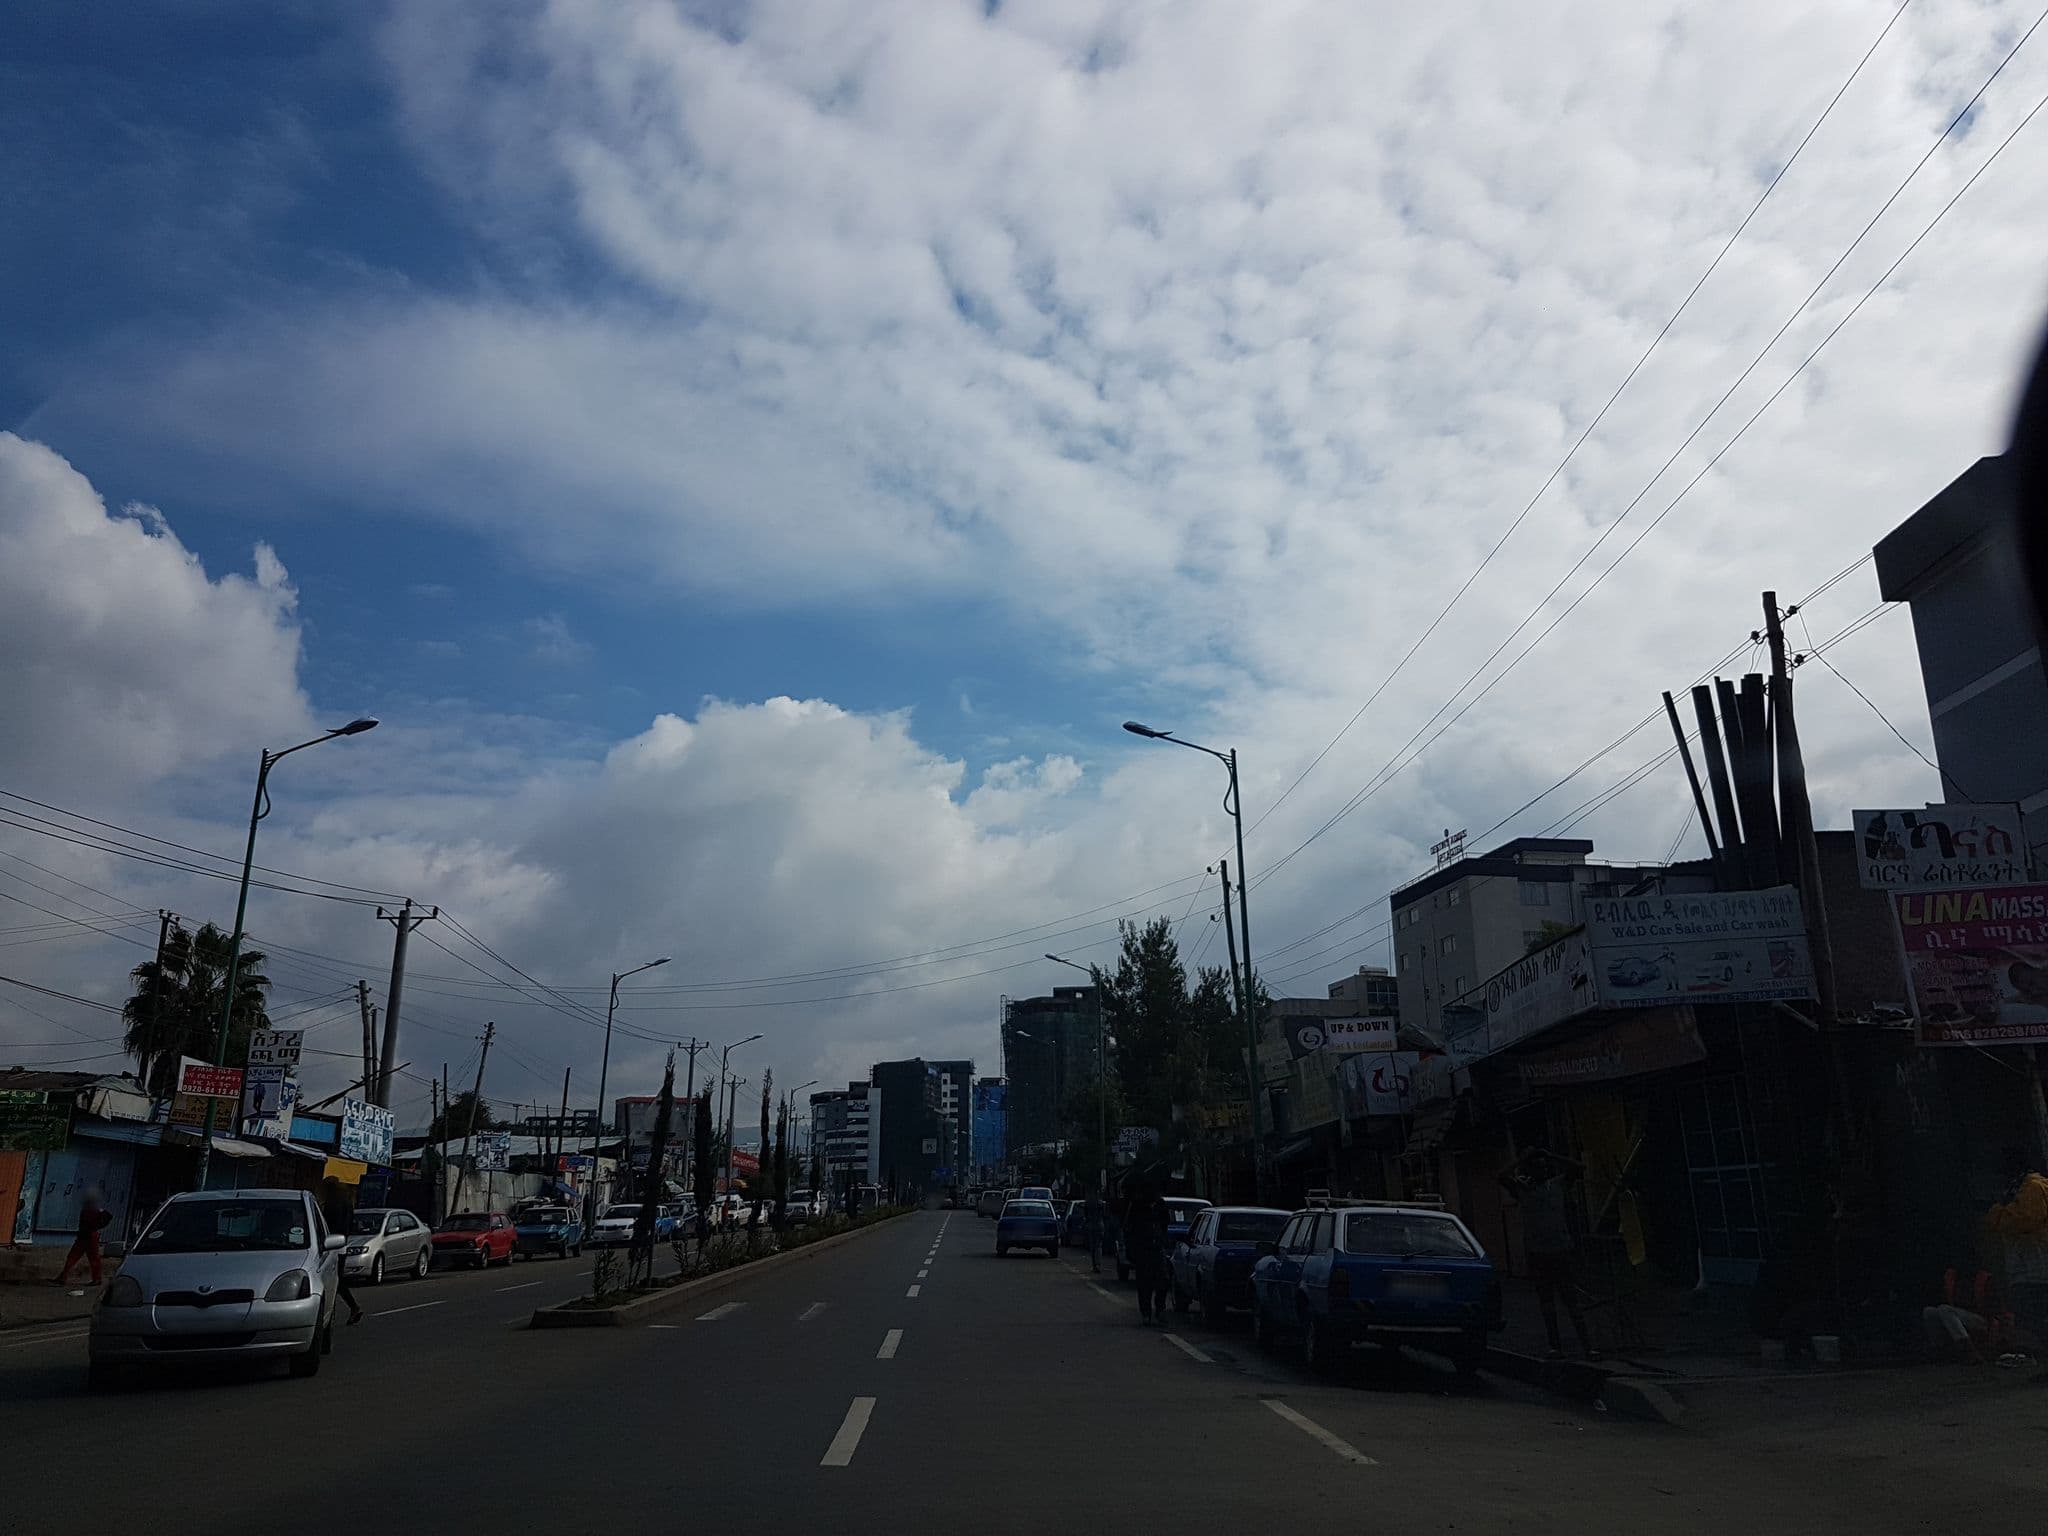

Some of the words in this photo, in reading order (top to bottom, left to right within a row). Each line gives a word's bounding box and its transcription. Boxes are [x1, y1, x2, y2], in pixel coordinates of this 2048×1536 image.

[1902, 892, 1989, 926] LINA
[1991, 895, 2048, 921] MASS
[1649, 924, 1673, 936] Car
[1731, 918, 1753, 930] Car
[1330, 1023, 1345, 1034] UP
[1346, 1023, 1354, 1033] &
[1357, 1020, 1389, 1032] DOWN
